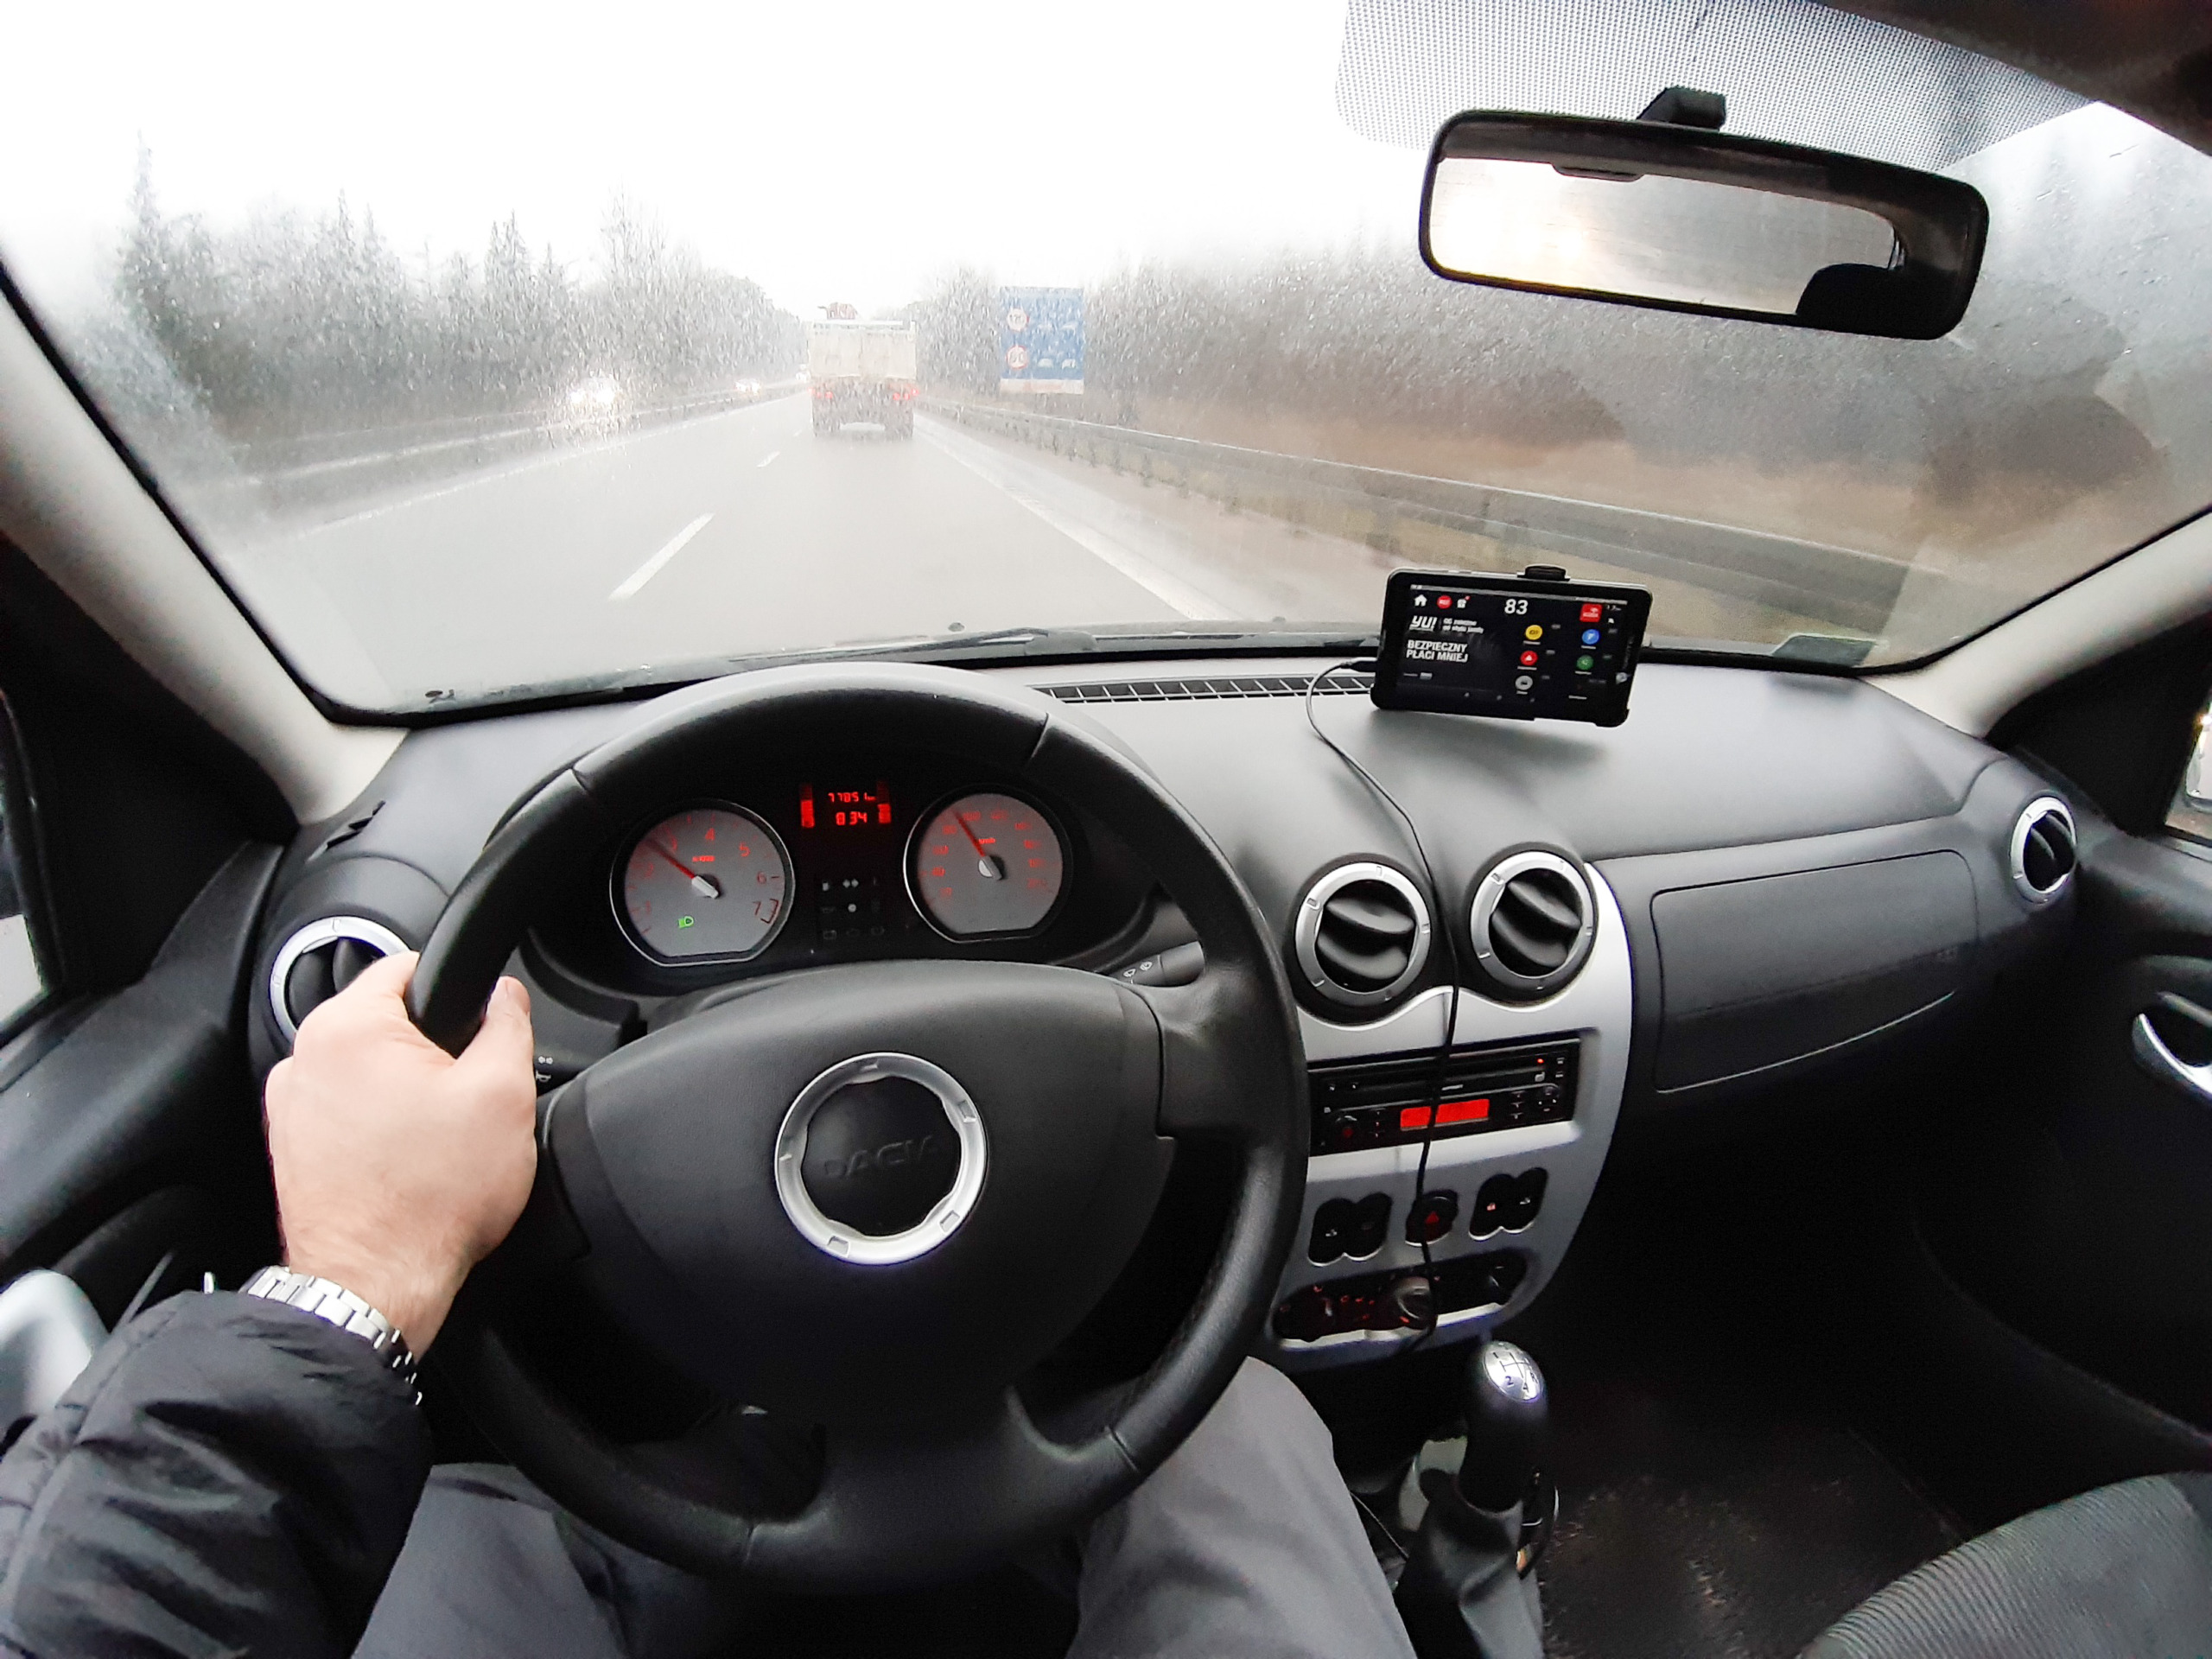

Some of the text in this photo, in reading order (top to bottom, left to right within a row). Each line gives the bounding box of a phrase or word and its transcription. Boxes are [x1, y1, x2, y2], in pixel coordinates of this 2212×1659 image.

[1504, 599, 1529, 615] 83
[1409, 615, 1438, 631] YU!
[1408, 639, 1468, 653] BEZPIECZNY
[1436, 652, 1469, 663] MNIEJ
[705, 828, 715, 841] 4
[739, 842, 751, 857] 5
[757, 870, 767, 885] 6
[753, 900, 762, 916] 7
[1505, 1376, 1515, 1386] 2
[1522, 1382, 1529, 1393] 4
